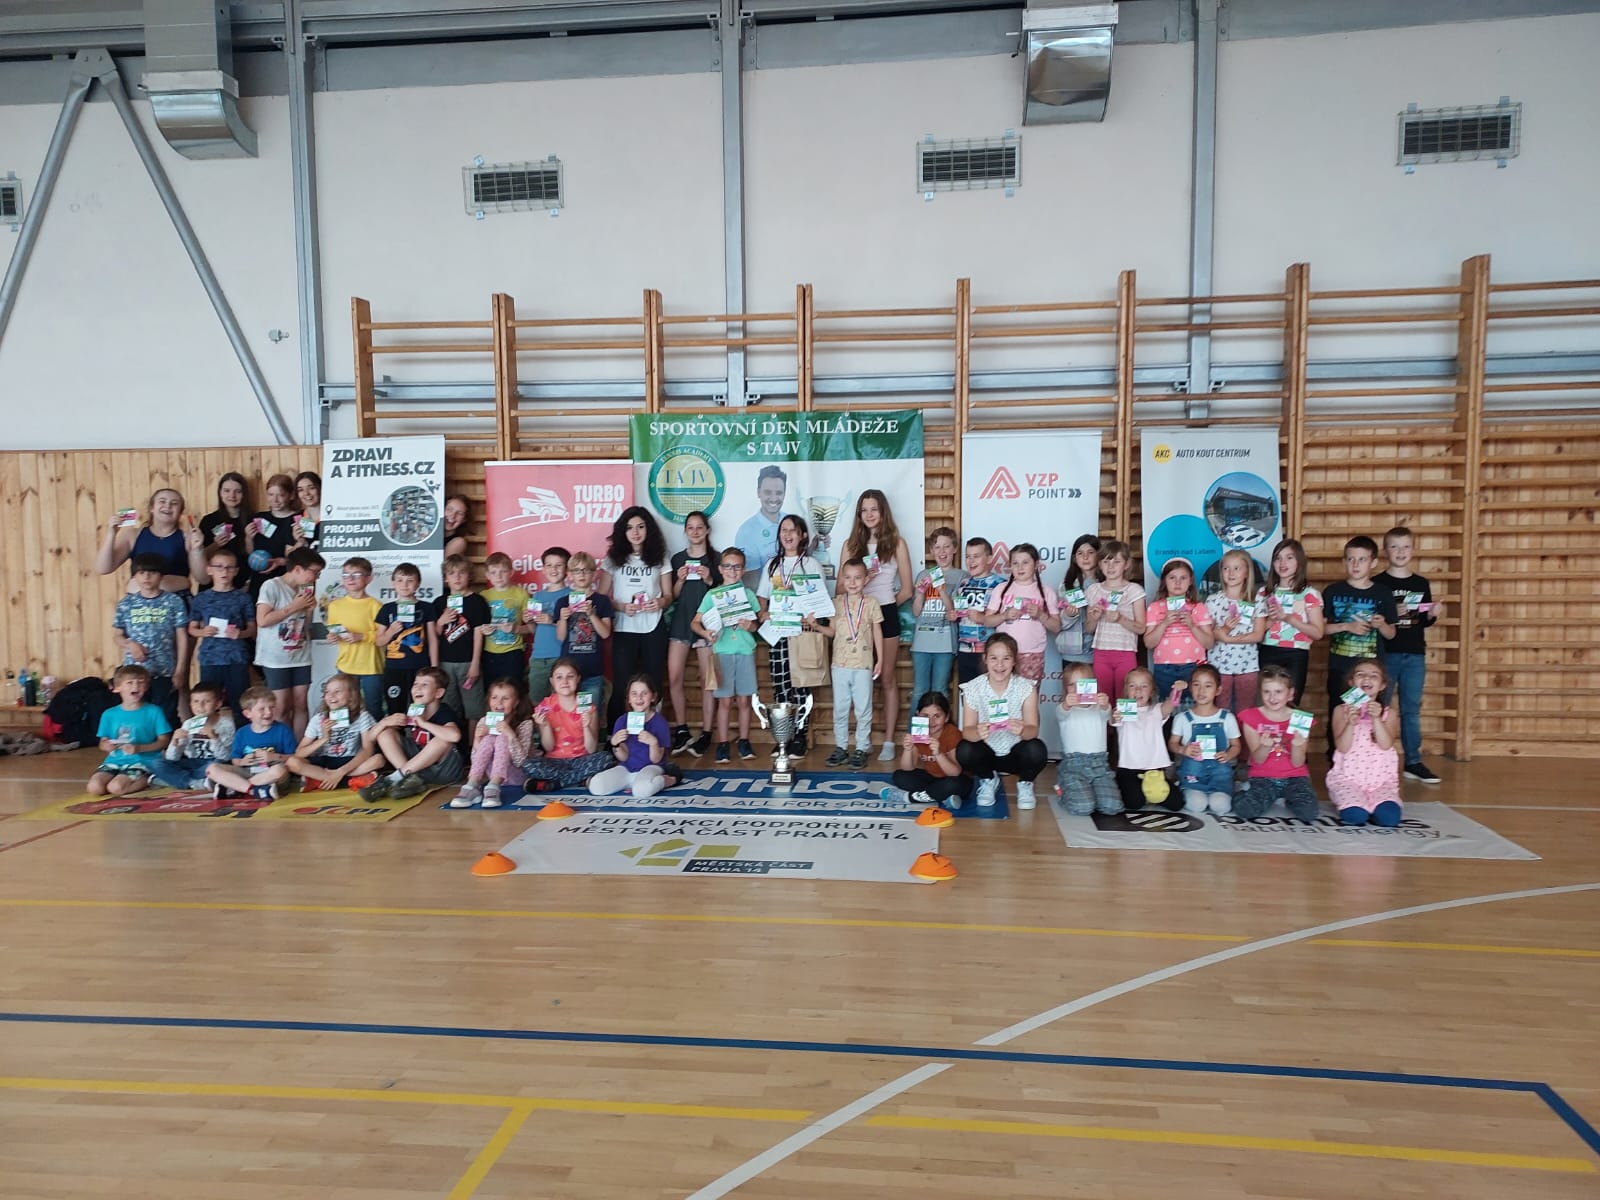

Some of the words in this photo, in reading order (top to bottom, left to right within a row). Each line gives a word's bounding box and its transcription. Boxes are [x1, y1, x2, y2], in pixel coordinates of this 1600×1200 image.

[649, 418, 757, 436] SPORTOVNÍ
[761, 420, 801, 435] DEN
[805, 416, 899, 434] MLÁDEŽE
[746, 441, 757, 456] S
[760, 441, 801, 456] TAJV
[1154, 449, 1170, 458] AKC
[1176, 448, 1195, 458] AUTO
[1195, 448, 1215, 458] KOUT
[1215, 448, 1251, 457] CENTRUM
[330, 465, 343, 478] A
[347, 461, 436, 478] FITNESS.CZ
[1025, 472, 1059, 487] VZP
[573, 484, 625, 502] TURBO
[1028, 488, 1067, 499] POINT
[574, 503, 624, 524] PIZZA
[323, 523, 380, 534] PRODEJNA
[322, 535, 373, 548] ŘÍČANY
[1039, 546, 1066, 563] OJE
[621, 565, 652, 577] TOKYO
[732, 800, 773, 808] ALL
[588, 817, 654, 826] TUTO
[659, 817, 723, 827] AKCI
[731, 820, 895, 831] PODPORUJE
[773, 830, 869, 840] PRAHA
